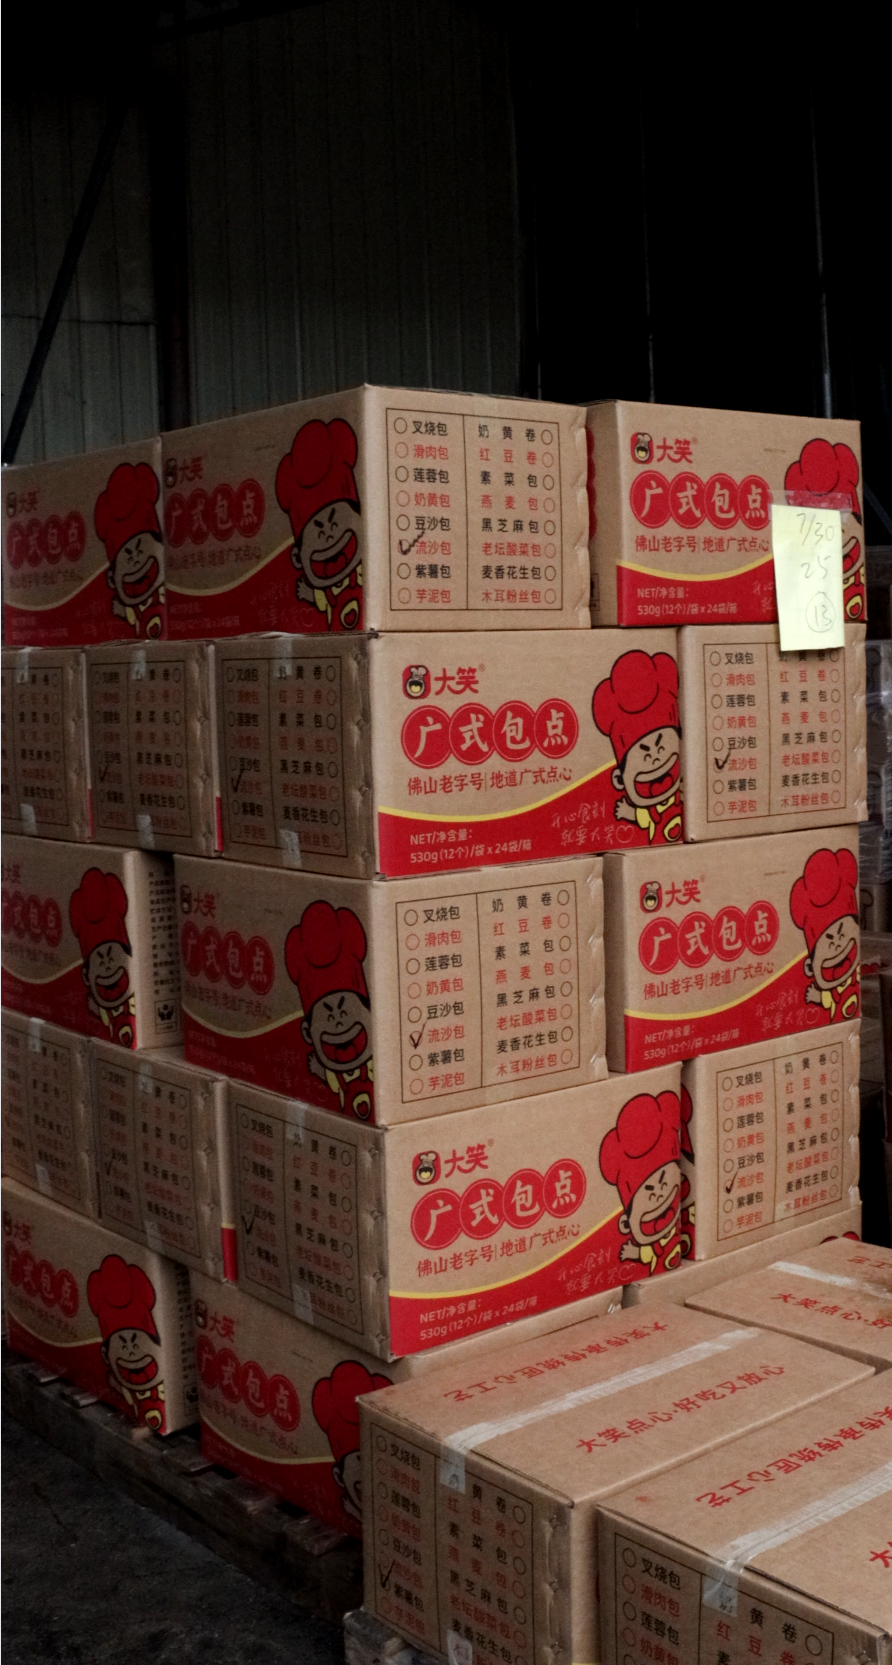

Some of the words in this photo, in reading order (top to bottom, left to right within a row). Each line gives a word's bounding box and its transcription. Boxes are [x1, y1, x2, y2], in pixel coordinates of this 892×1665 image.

[412, 420, 448, 436] 叉烧包
[478, 424, 536, 442] 奶黄卷
[413, 445, 449, 460] 滑肉包
[479, 448, 537, 465] 红豆卷
[657, 437, 693, 463] 大笑
[413, 468, 449, 483] 莲蓉包
[481, 471, 538, 487] 素菜包
[415, 493, 450, 507] 奶黄包
[481, 495, 538, 511] 燕麦包
[640, 478, 766, 521] 广式包点
[415, 517, 450, 531] 豆沙包
[482, 518, 539, 533] 黑芝麻包
[416, 541, 451, 555] 流沙包
[482, 542, 541, 556] 老坛酸菜包
[415, 564, 450, 579] 紫薯包
[482, 565, 541, 579] 麦香花生包
[801, 555, 831, 579] 25
[416, 589, 450, 603] 芋泥包
[482, 590, 541, 603] 木耳粉丝包
[725, 652, 754, 665] 叉烧包
[434, 666, 479, 696] 大笑
[726, 674, 755, 686] 滑肉包
[780, 670, 826, 683] 红豆卷
[726, 694, 755, 708] 莲蓉包
[781, 690, 827, 704] 素菜包
[727, 716, 756, 729] 奶黄包
[781, 711, 827, 724] 燕麦包
[414, 709, 569, 758] 广式包点
[782, 731, 827, 745] 黑芝麻包
[728, 736, 756, 749] 豆沙包
[729, 757, 757, 771] 流沙包
[782, 752, 829, 766] 老坛酸菜包
[728, 778, 757, 792] 紫薯包
[782, 771, 829, 787] 麦香花生包
[729, 800, 757, 814] 芋泥包
[781, 793, 829, 807] 木耳粉丝包
[665, 879, 701, 907] 大笑
[492, 892, 552, 913] 奶黄卷
[424, 905, 460, 923] 叉烧包
[493, 915, 552, 936] 红豆卷
[425, 930, 461, 947] 滑肉包
[649, 909, 772, 967] 广式包点
[185, 931, 268, 983] 广式包点
[495, 939, 553, 960] 素菜包
[425, 953, 462, 971] 莲蓉包
[496, 962, 554, 984] 燕麦包
[426, 978, 463, 996] 奶黄包
[497, 985, 555, 1008] 黑芝麻包
[427, 1001, 464, 1020] 豆沙包
[497, 1007, 557, 1030] 老坛酸菜包
[427, 1025, 464, 1043] 流沙包
[497, 1030, 558, 1054] 麦香花生包
[428, 1048, 464, 1067] 紫薯包
[497, 1053, 557, 1076] 木耳粉丝包
[428, 1071, 464, 1090] 芋泥包
[736, 1072, 763, 1088] 叉烧包
[737, 1092, 763, 1108] 滑肉包
[737, 1112, 764, 1129] 莲蓉包
[737, 1132, 764, 1149] 奶黄包
[444, 1142, 488, 1178] 大笑
[738, 1152, 764, 1169] 豆沙包
[737, 1172, 764, 1188] 流沙包
[424, 1170, 576, 1242] 广式包点
[737, 1191, 763, 1209] 紫薯包
[737, 1211, 763, 1229] 芋泥包
[209, 1314, 235, 1343] 大笑
[201, 1345, 293, 1424] 广式包点
[869, 1541, 892, 1568] 大
[641, 1558, 681, 1590] 叉烧包
[641, 1585, 680, 1617] 滑肉包
[641, 1612, 679, 1646] 莲蓉包
